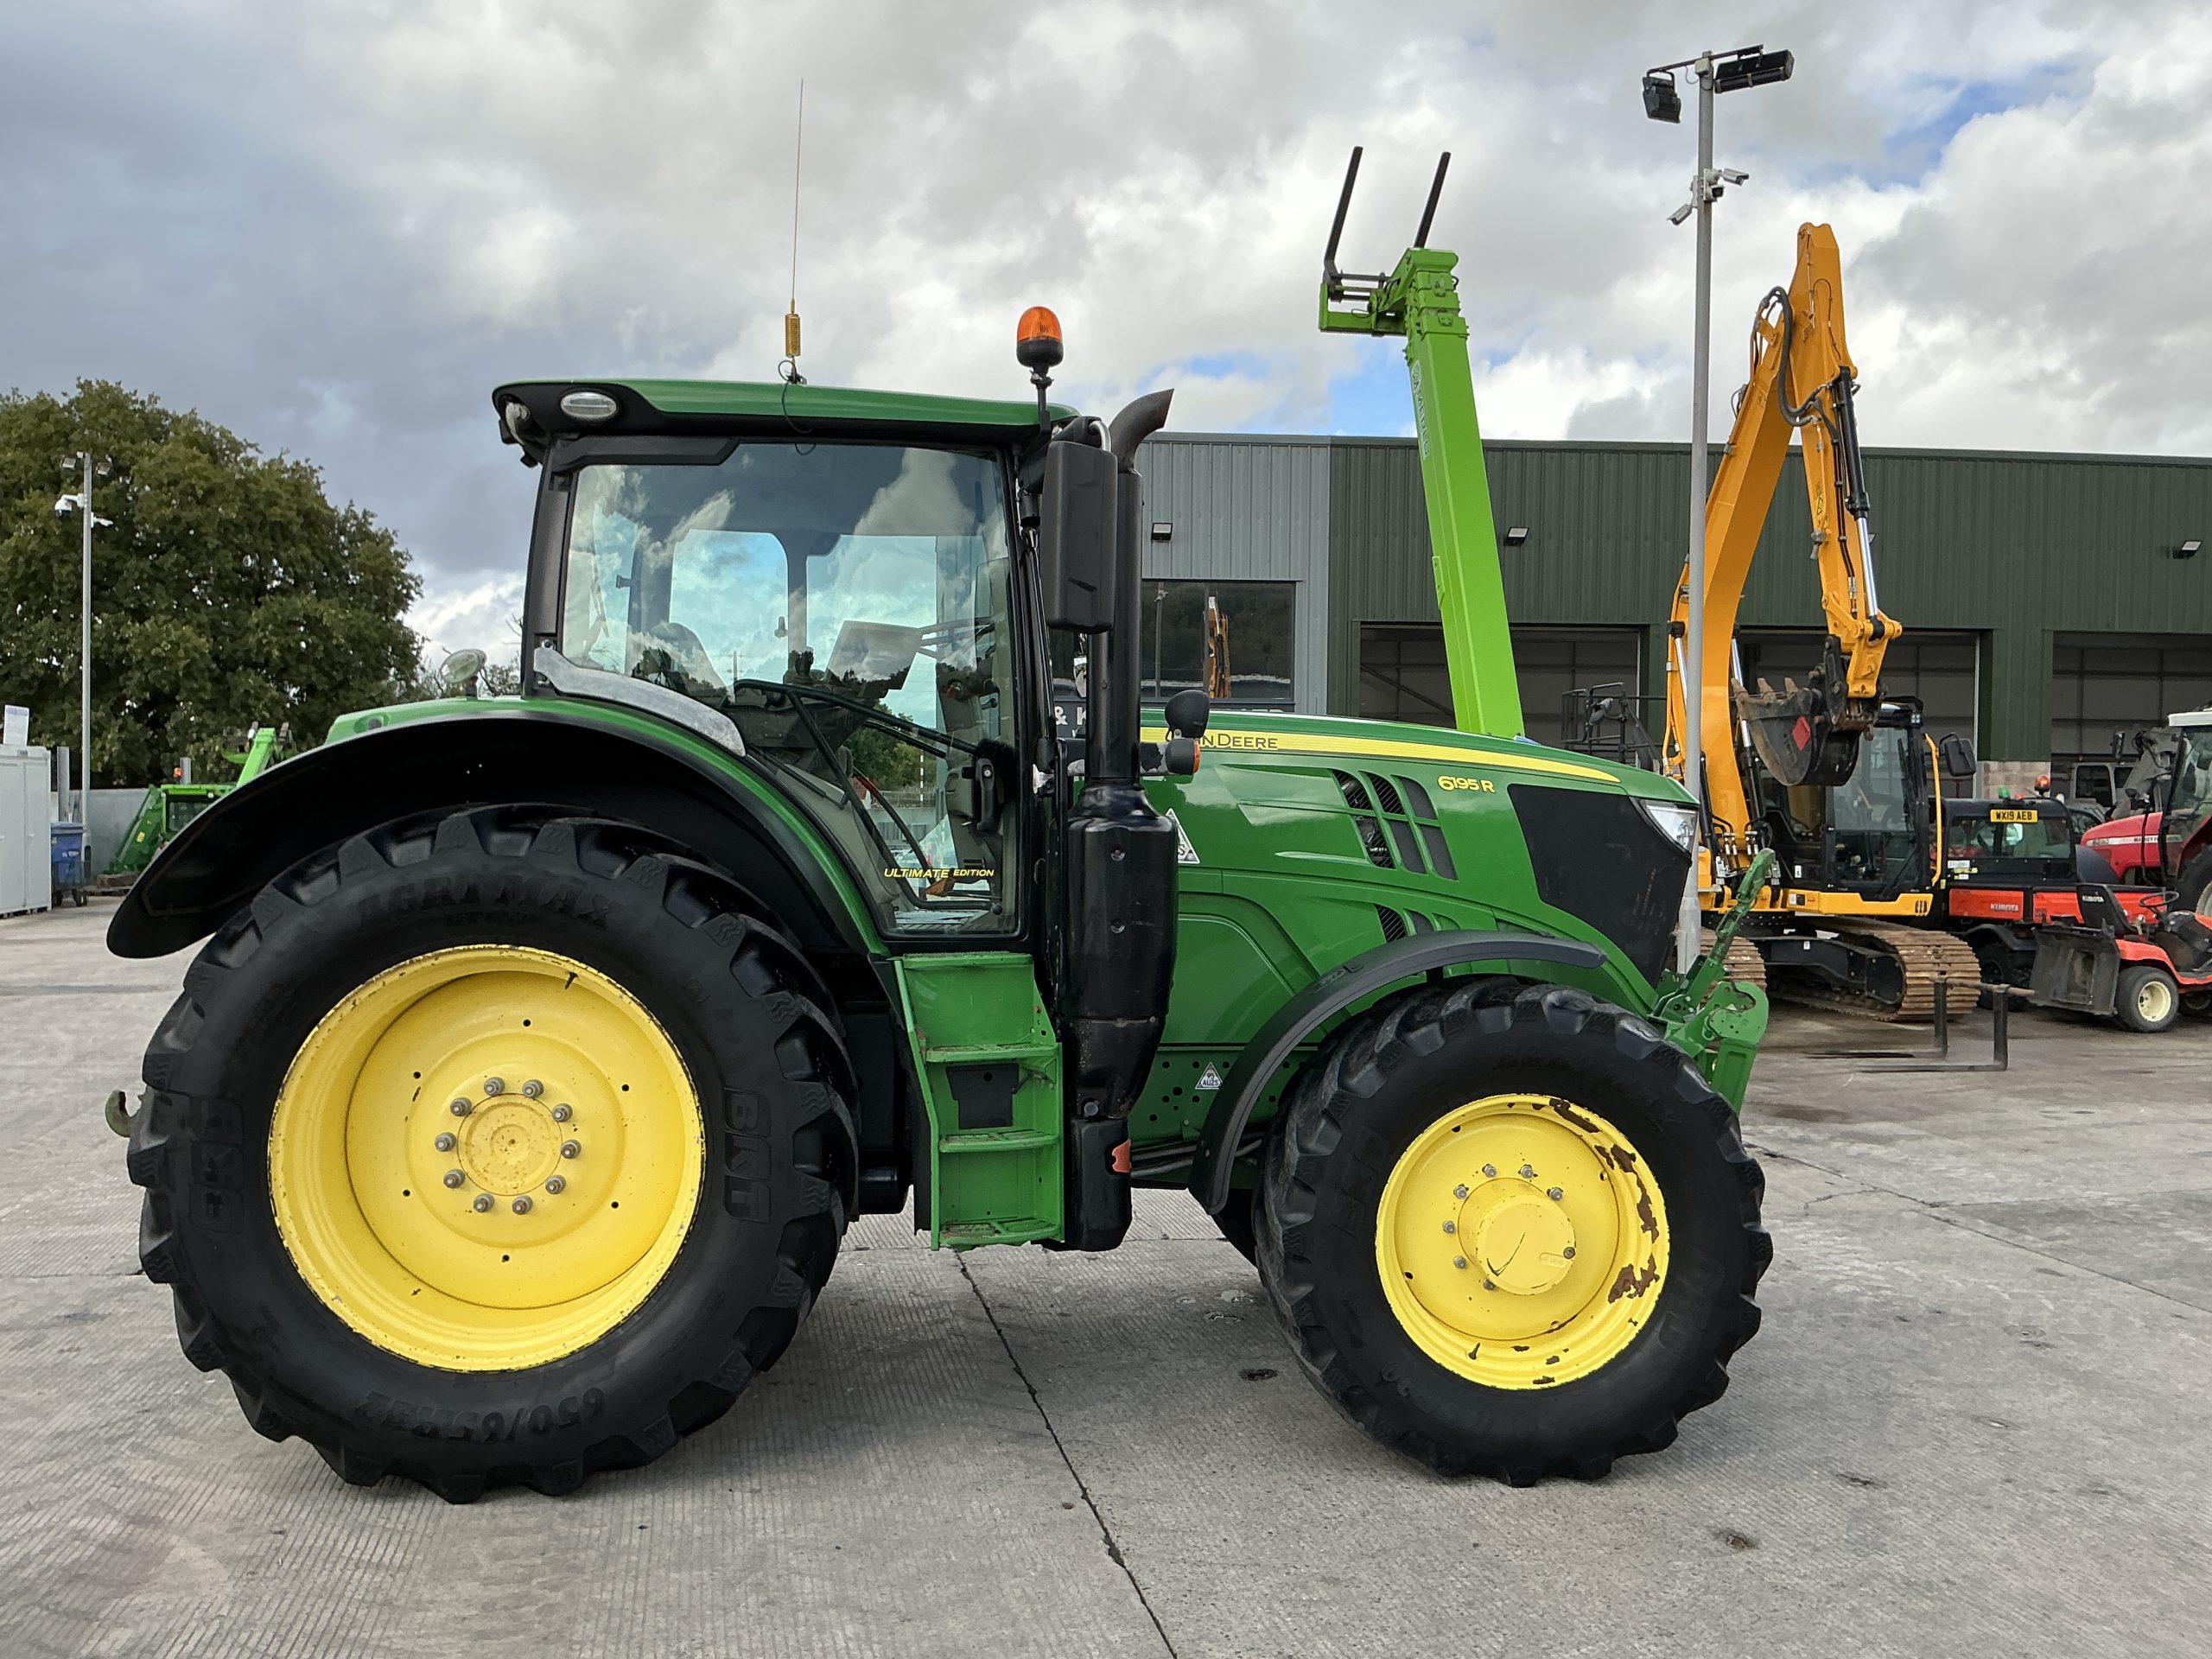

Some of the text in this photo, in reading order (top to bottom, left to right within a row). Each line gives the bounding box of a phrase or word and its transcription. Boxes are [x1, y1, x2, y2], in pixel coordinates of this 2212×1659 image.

[1053, 706, 1068, 726] &
[1217, 733, 1278, 749] DEERE
[1438, 775, 1496, 793] 6195 R
[1995, 810, 2032, 821] WX19 AEB
[883, 868, 995, 879] ULTIMATE EDITION
[1990, 903, 2019, 912] KUBOTA
[727, 1090, 767, 1220] BKT
